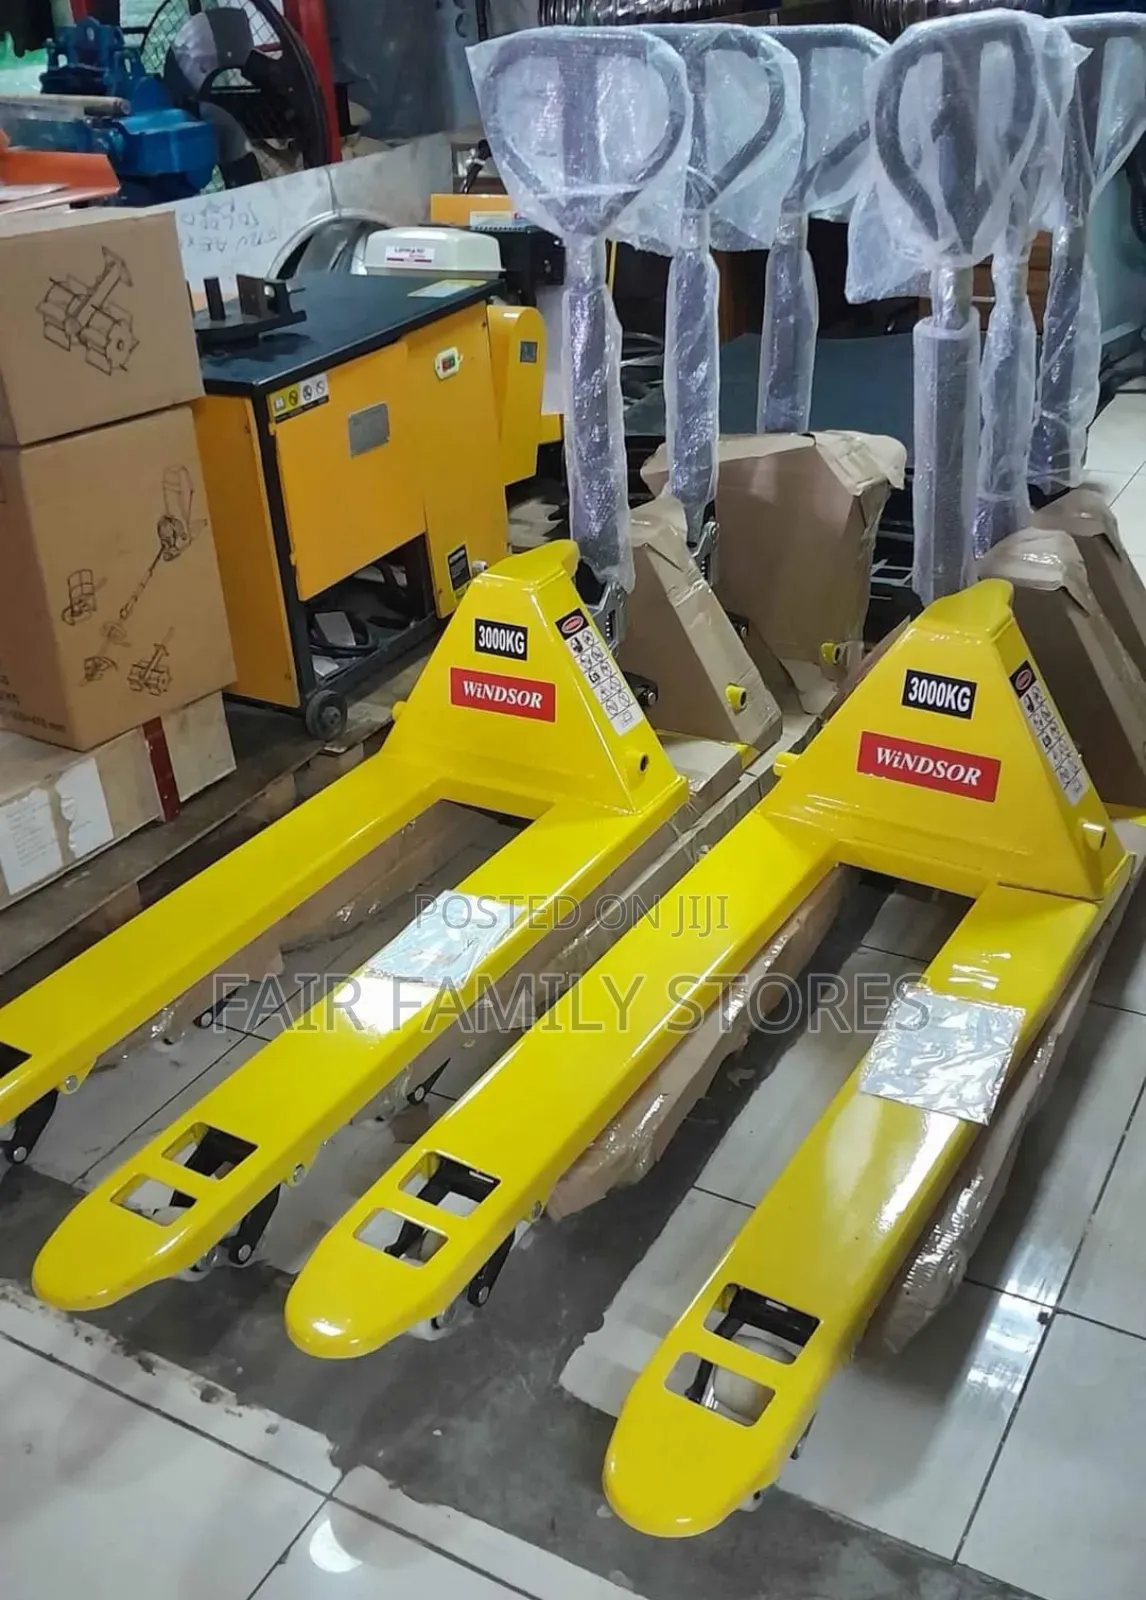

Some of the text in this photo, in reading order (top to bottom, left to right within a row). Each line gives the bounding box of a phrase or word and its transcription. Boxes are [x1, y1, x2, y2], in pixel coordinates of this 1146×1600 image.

[478, 625, 525, 654] 3000KG
[463, 680, 543, 709] WiNDSOR
[908, 676, 971, 712] 3000KG
[876, 747, 982, 786] WiNDSOR
